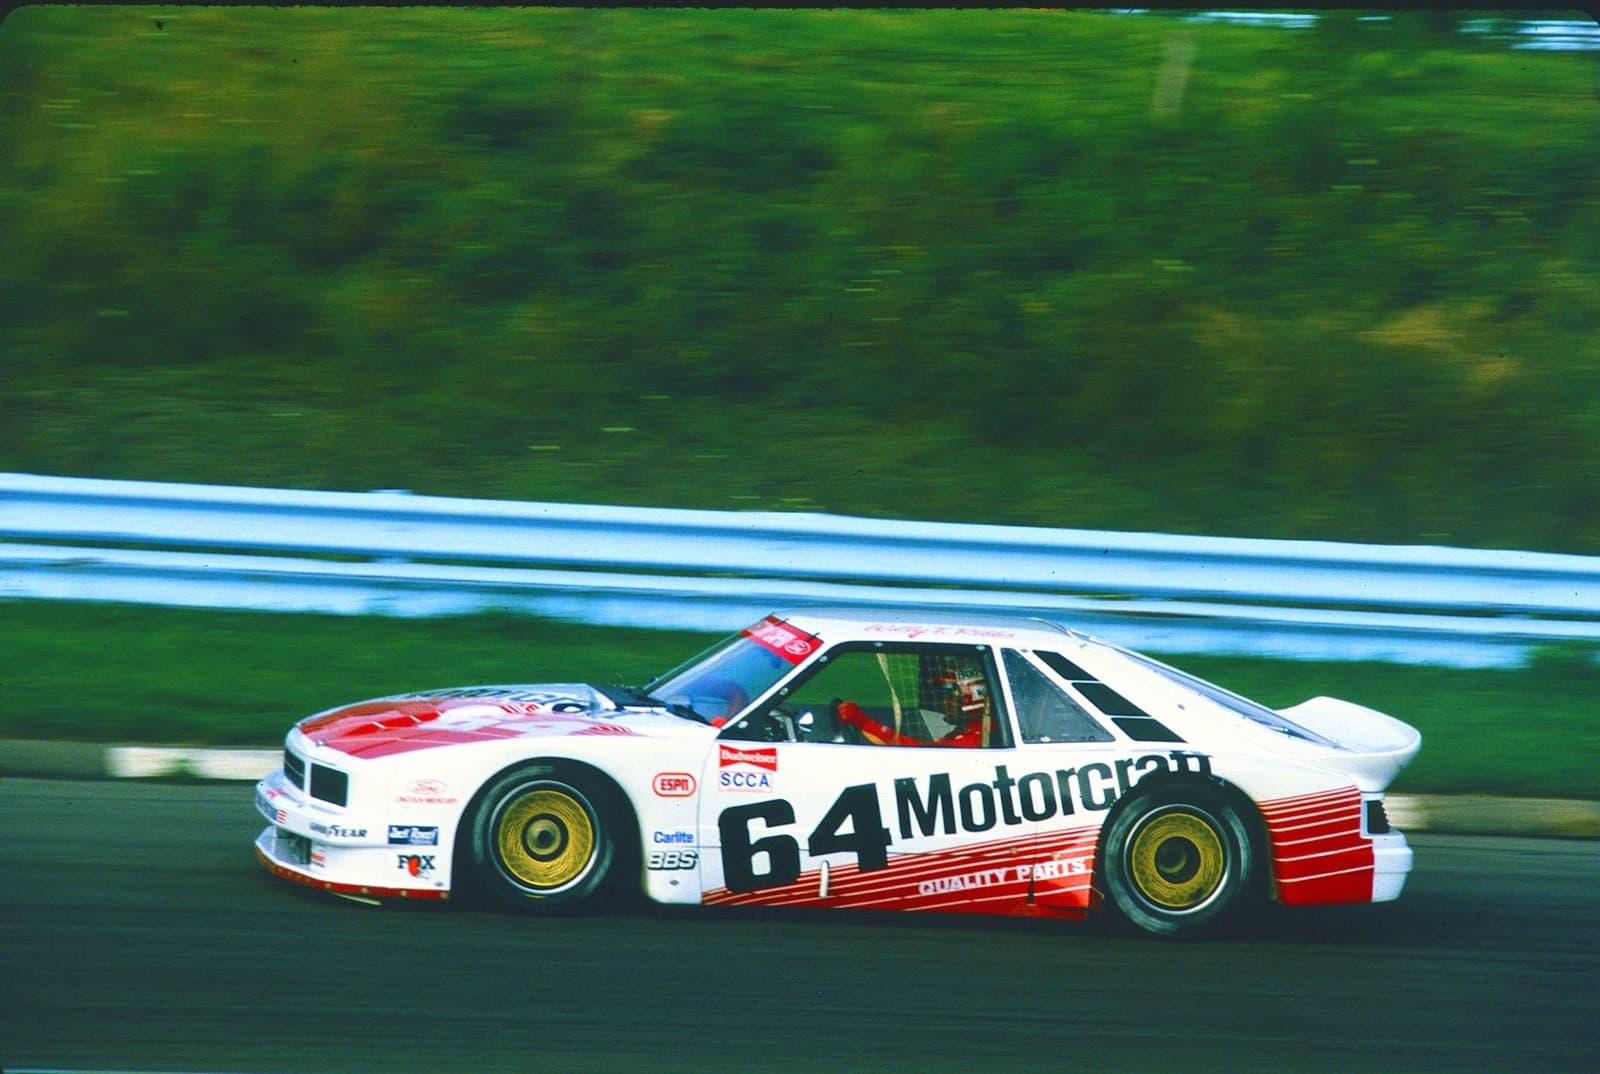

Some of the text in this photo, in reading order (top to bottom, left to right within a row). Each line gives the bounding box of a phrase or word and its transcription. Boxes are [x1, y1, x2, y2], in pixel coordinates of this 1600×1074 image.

[659, 777, 689, 792] ESPN
[720, 771, 770, 788] SCCA
[894, 750, 1213, 841] Motorcra
[653, 831, 694, 844] Carlite
[718, 783, 893, 893] 64
[647, 849, 699, 871] BBS
[918, 858, 1088, 896] QUALITY PARTS
